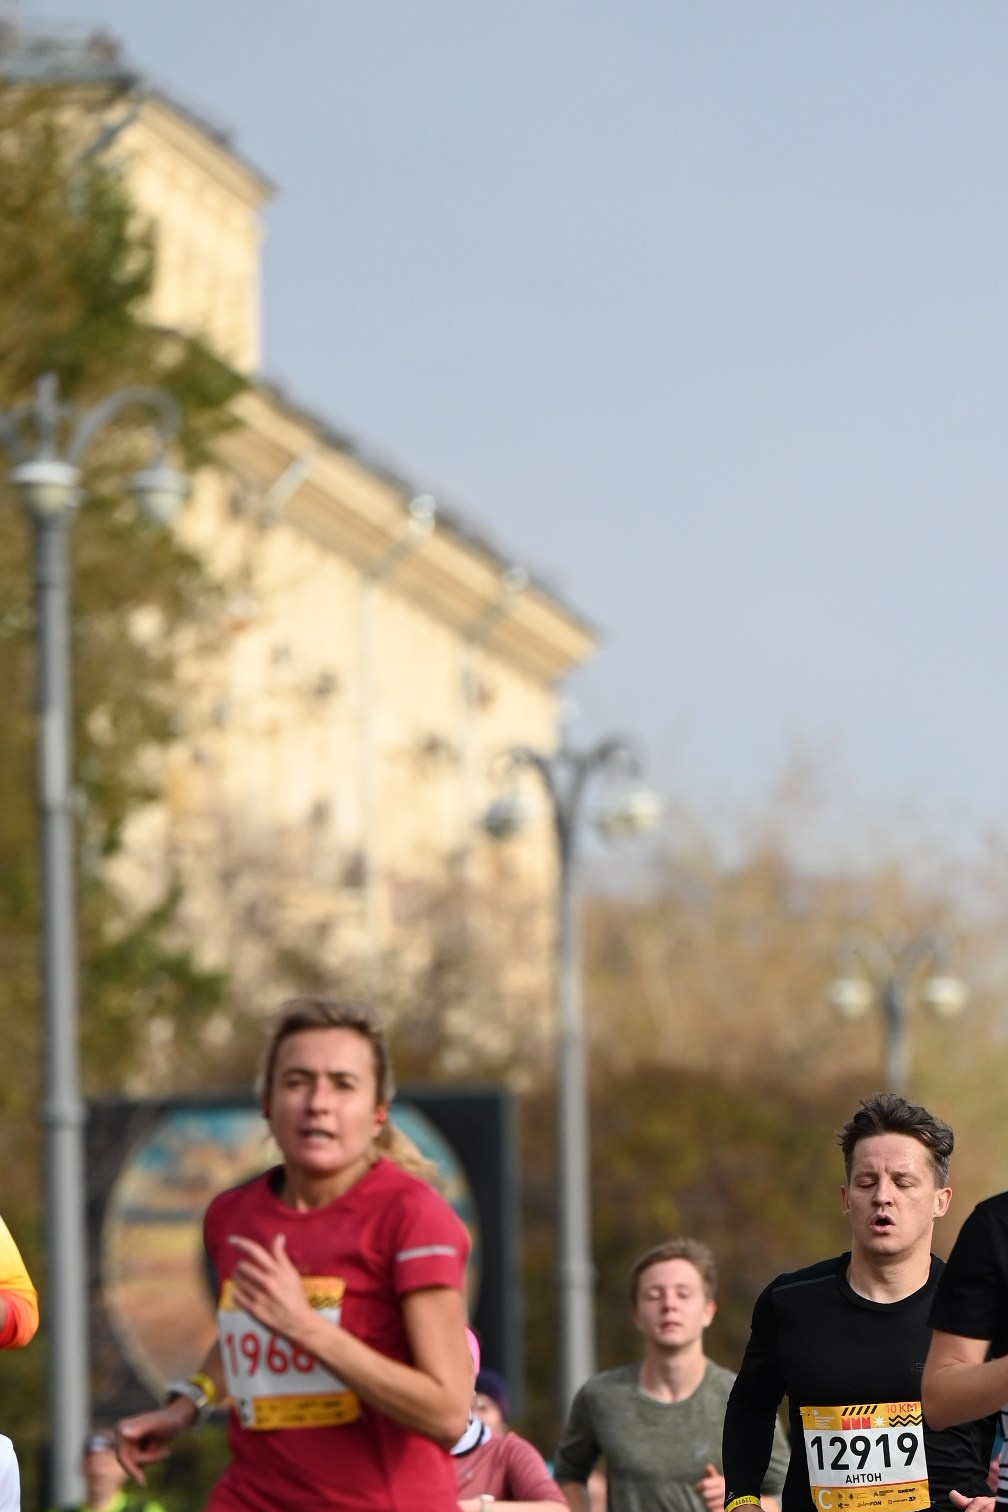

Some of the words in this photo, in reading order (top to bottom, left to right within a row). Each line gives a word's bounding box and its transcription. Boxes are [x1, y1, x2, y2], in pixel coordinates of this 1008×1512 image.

[886, 1404, 897, 1414] 10
[811, 1432, 919, 1471] 12919
[845, 1473, 882, 1484] АНТОН
